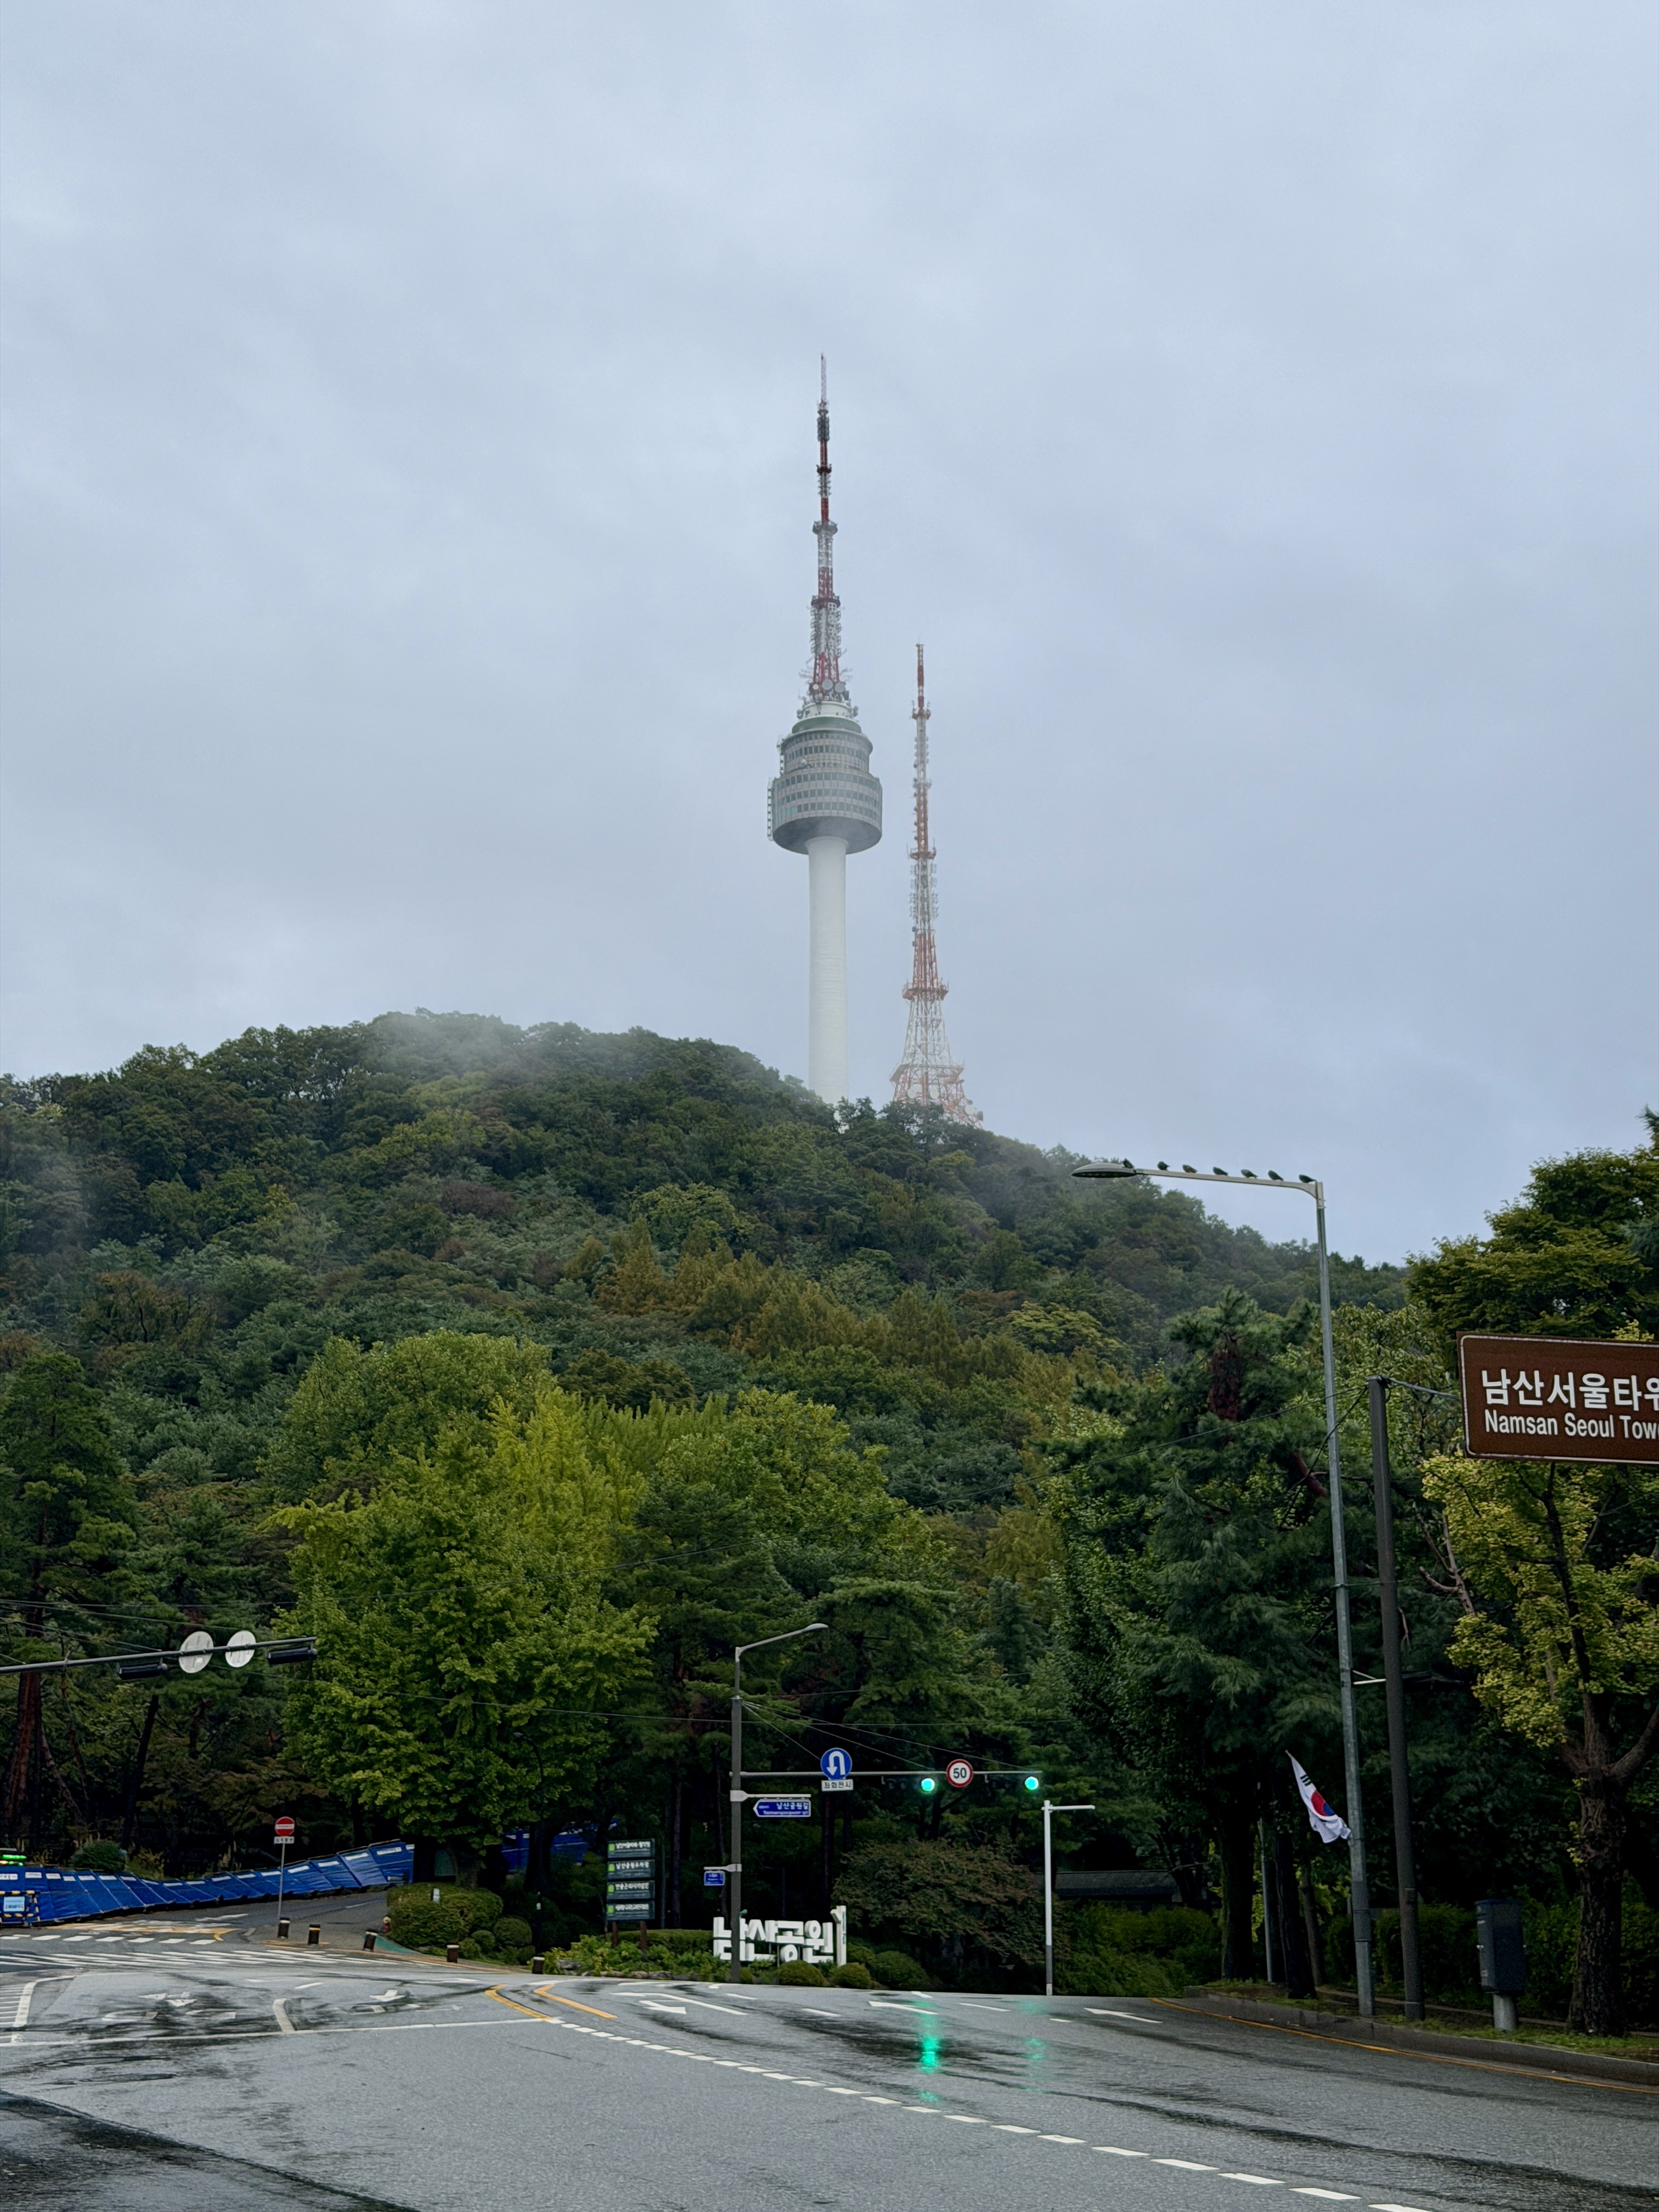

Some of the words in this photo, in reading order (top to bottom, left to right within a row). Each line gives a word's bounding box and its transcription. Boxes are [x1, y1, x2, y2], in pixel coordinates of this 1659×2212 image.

[1485, 1409, 1559, 1436] Namsan
[1564, 1412, 1615, 1438] Seoul
[1619, 1415, 1659, 1440] Tow
[953, 1767, 967, 1779] 50
[713, 1917, 834, 1963] 남산공원
